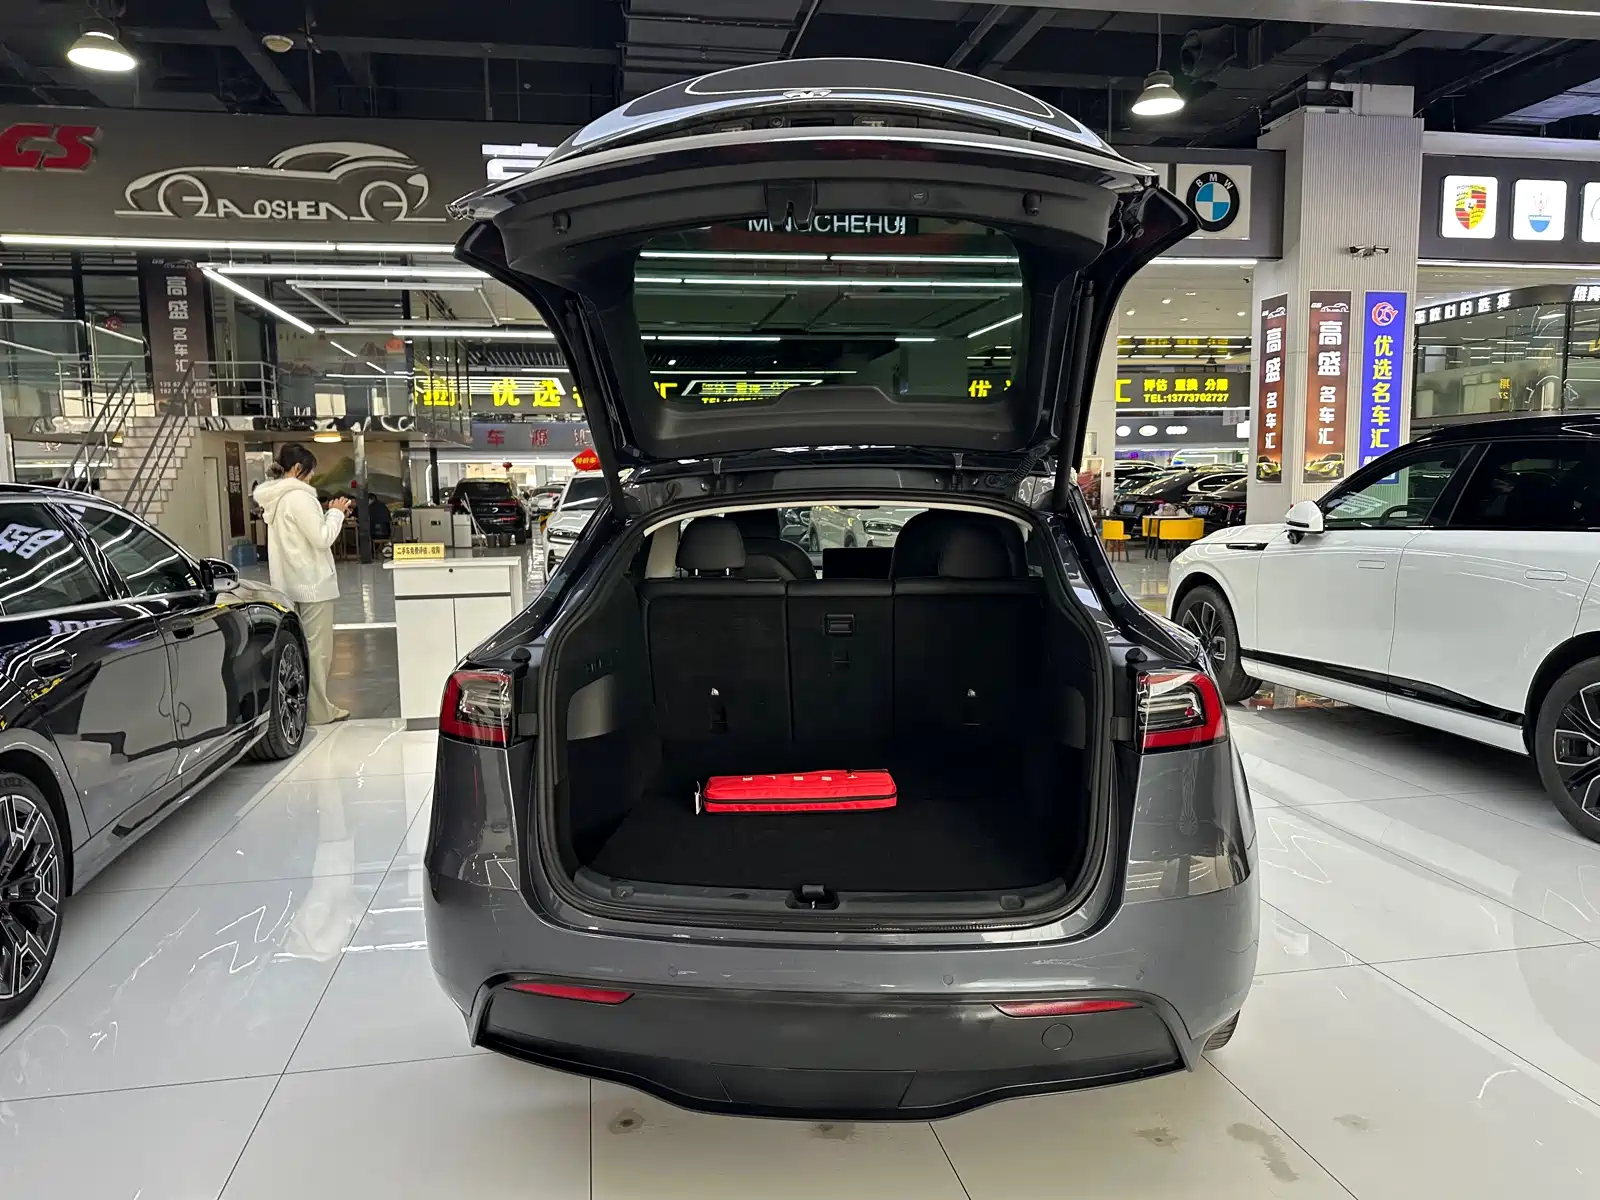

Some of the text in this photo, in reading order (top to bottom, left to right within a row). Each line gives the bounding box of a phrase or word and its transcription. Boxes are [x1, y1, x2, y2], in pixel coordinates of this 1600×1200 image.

[1195, 173, 1234, 190] BMW
[748, 214, 906, 235] MICHEHUI
[1144, 394, 1229, 403] TEL:13773702727
[1370, 335, 1393, 449] 优选名车汇
